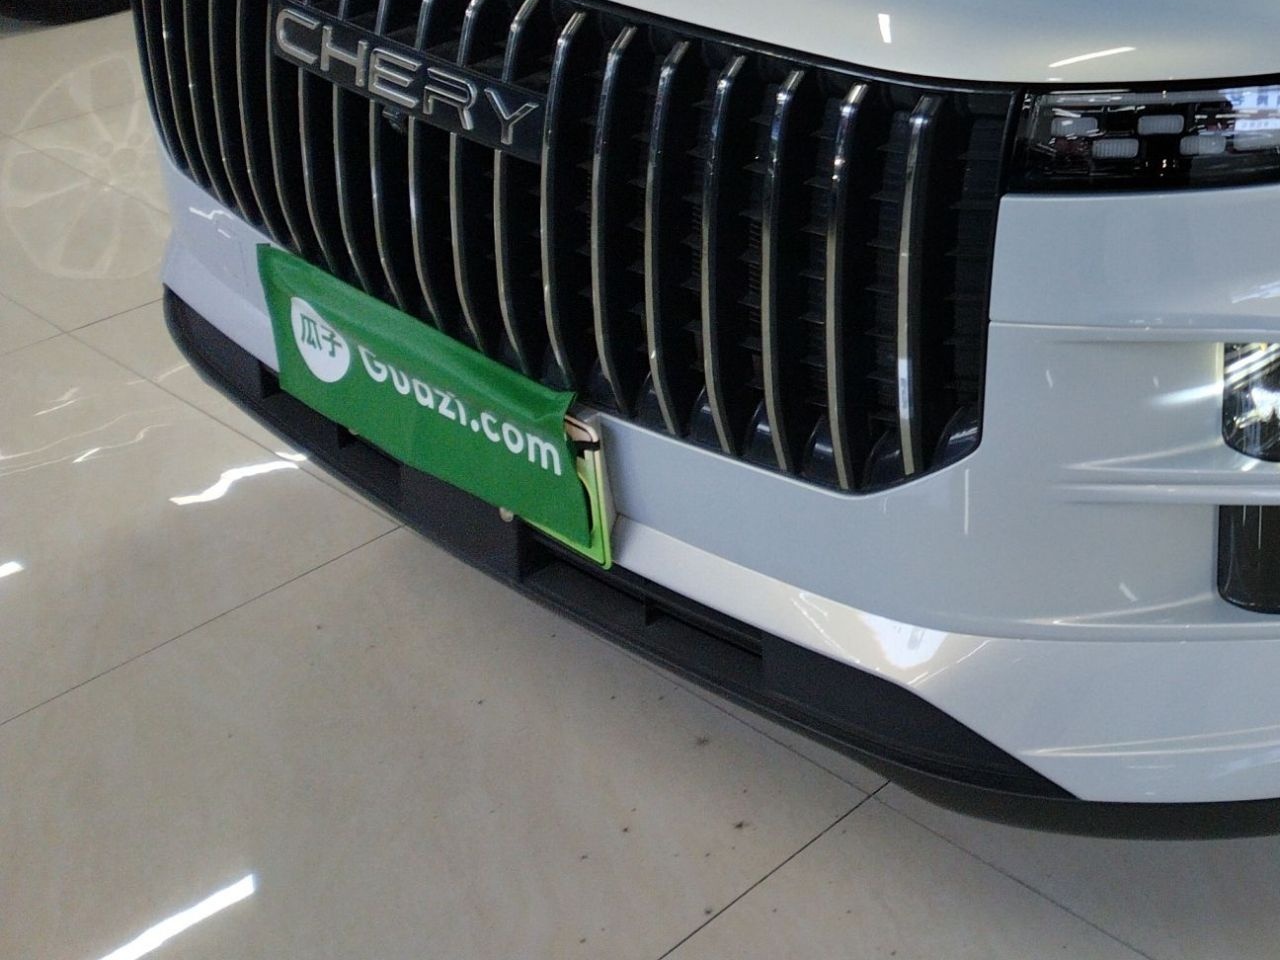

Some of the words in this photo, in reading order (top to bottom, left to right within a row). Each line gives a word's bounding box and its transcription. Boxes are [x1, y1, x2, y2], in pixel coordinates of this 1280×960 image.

[275, 8, 540, 145] CHERY
[300, 312, 343, 358] 瓜子
[357, 344, 562, 476] Guazi.com
